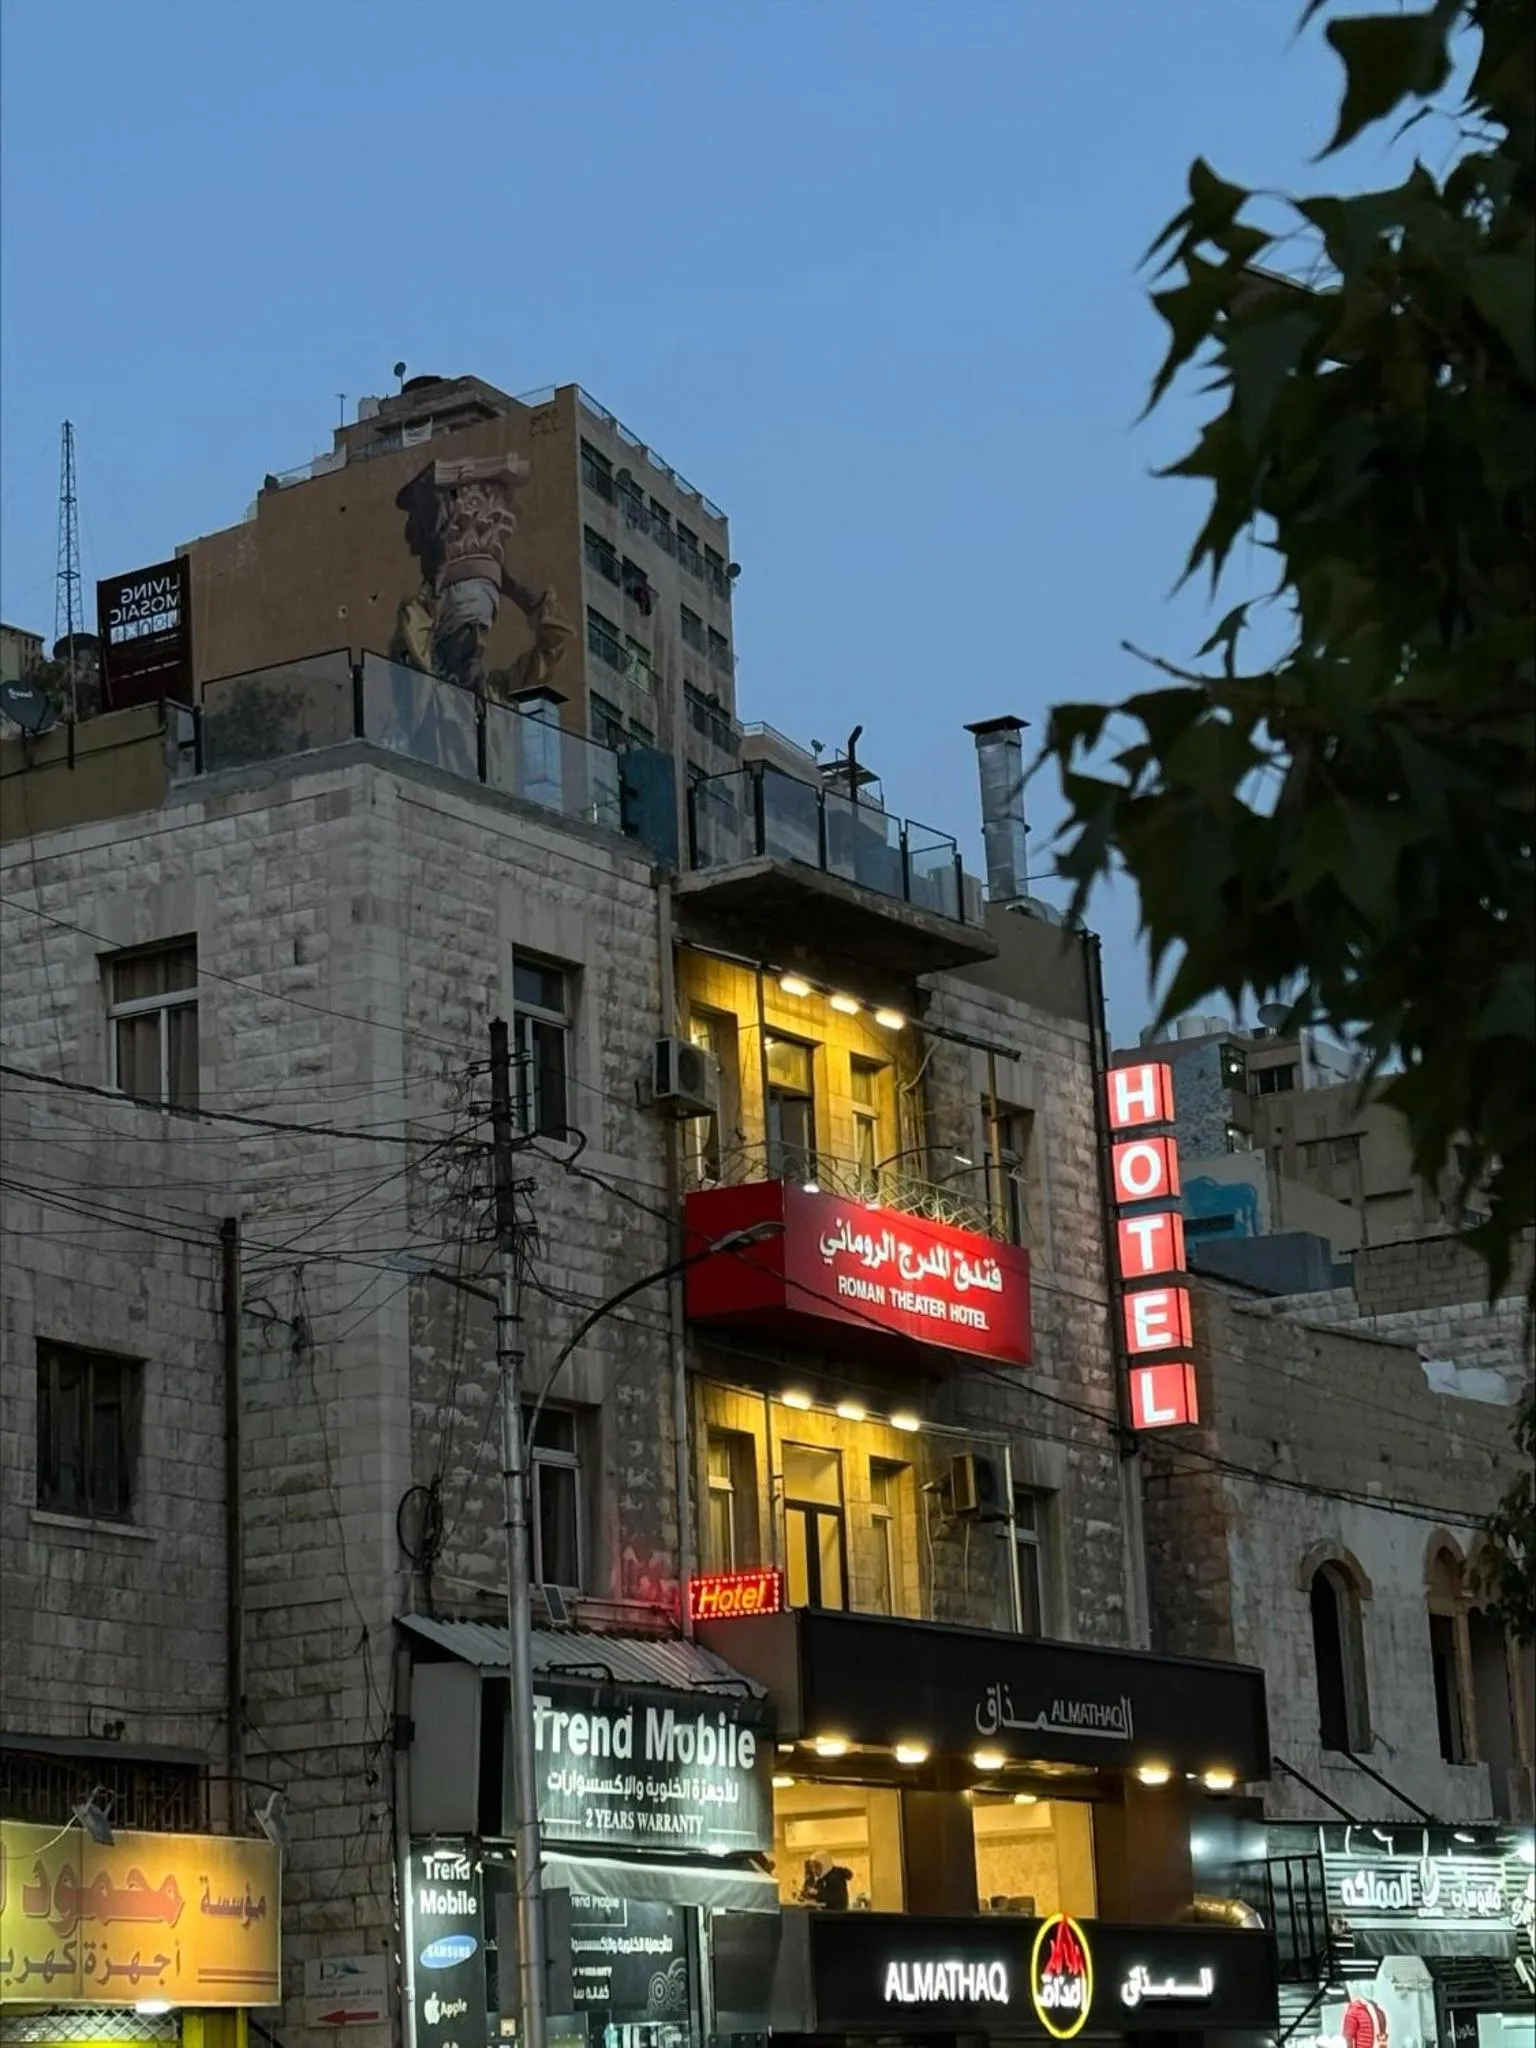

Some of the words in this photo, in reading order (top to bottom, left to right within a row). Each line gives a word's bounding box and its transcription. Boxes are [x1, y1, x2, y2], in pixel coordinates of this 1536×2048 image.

[820, 1217, 895, 1268] الروماني
[1113, 1067, 1177, 1424] HOTEL
[898, 1243, 951, 1280] المدرج
[953, 1250, 1003, 1292] فندق
[837, 1275, 885, 1305] ROMAN
[889, 1288, 947, 1320] THEATER
[950, 1304, 989, 1330] HOTEL
[699, 1580, 766, 1613] Hotel
[533, 1694, 633, 1760] Trend
[645, 1707, 756, 1769] Mobile
[1051, 1699, 1125, 1729] ALMATHAQ
[547, 1769, 644, 1800] والإكسسوارات
[646, 1776, 690, 1804] الخلوية
[692, 1778, 739, 1808] للأجهزة
[585, 1809, 594, 1827] 2
[595, 1808, 635, 1830] YEARS
[637, 1812, 705, 1834] WARRANTY
[422, 1855, 471, 1881] Trend
[22, 1860, 185, 1939] محمود
[199, 1876, 266, 1931] مؤسسة
[420, 1889, 477, 1915] Mobile
[84, 1938, 181, 1985] أجهزة
[884, 1961, 1009, 2005] ALMATHAQ
[440, 1998, 468, 2018] Apple
